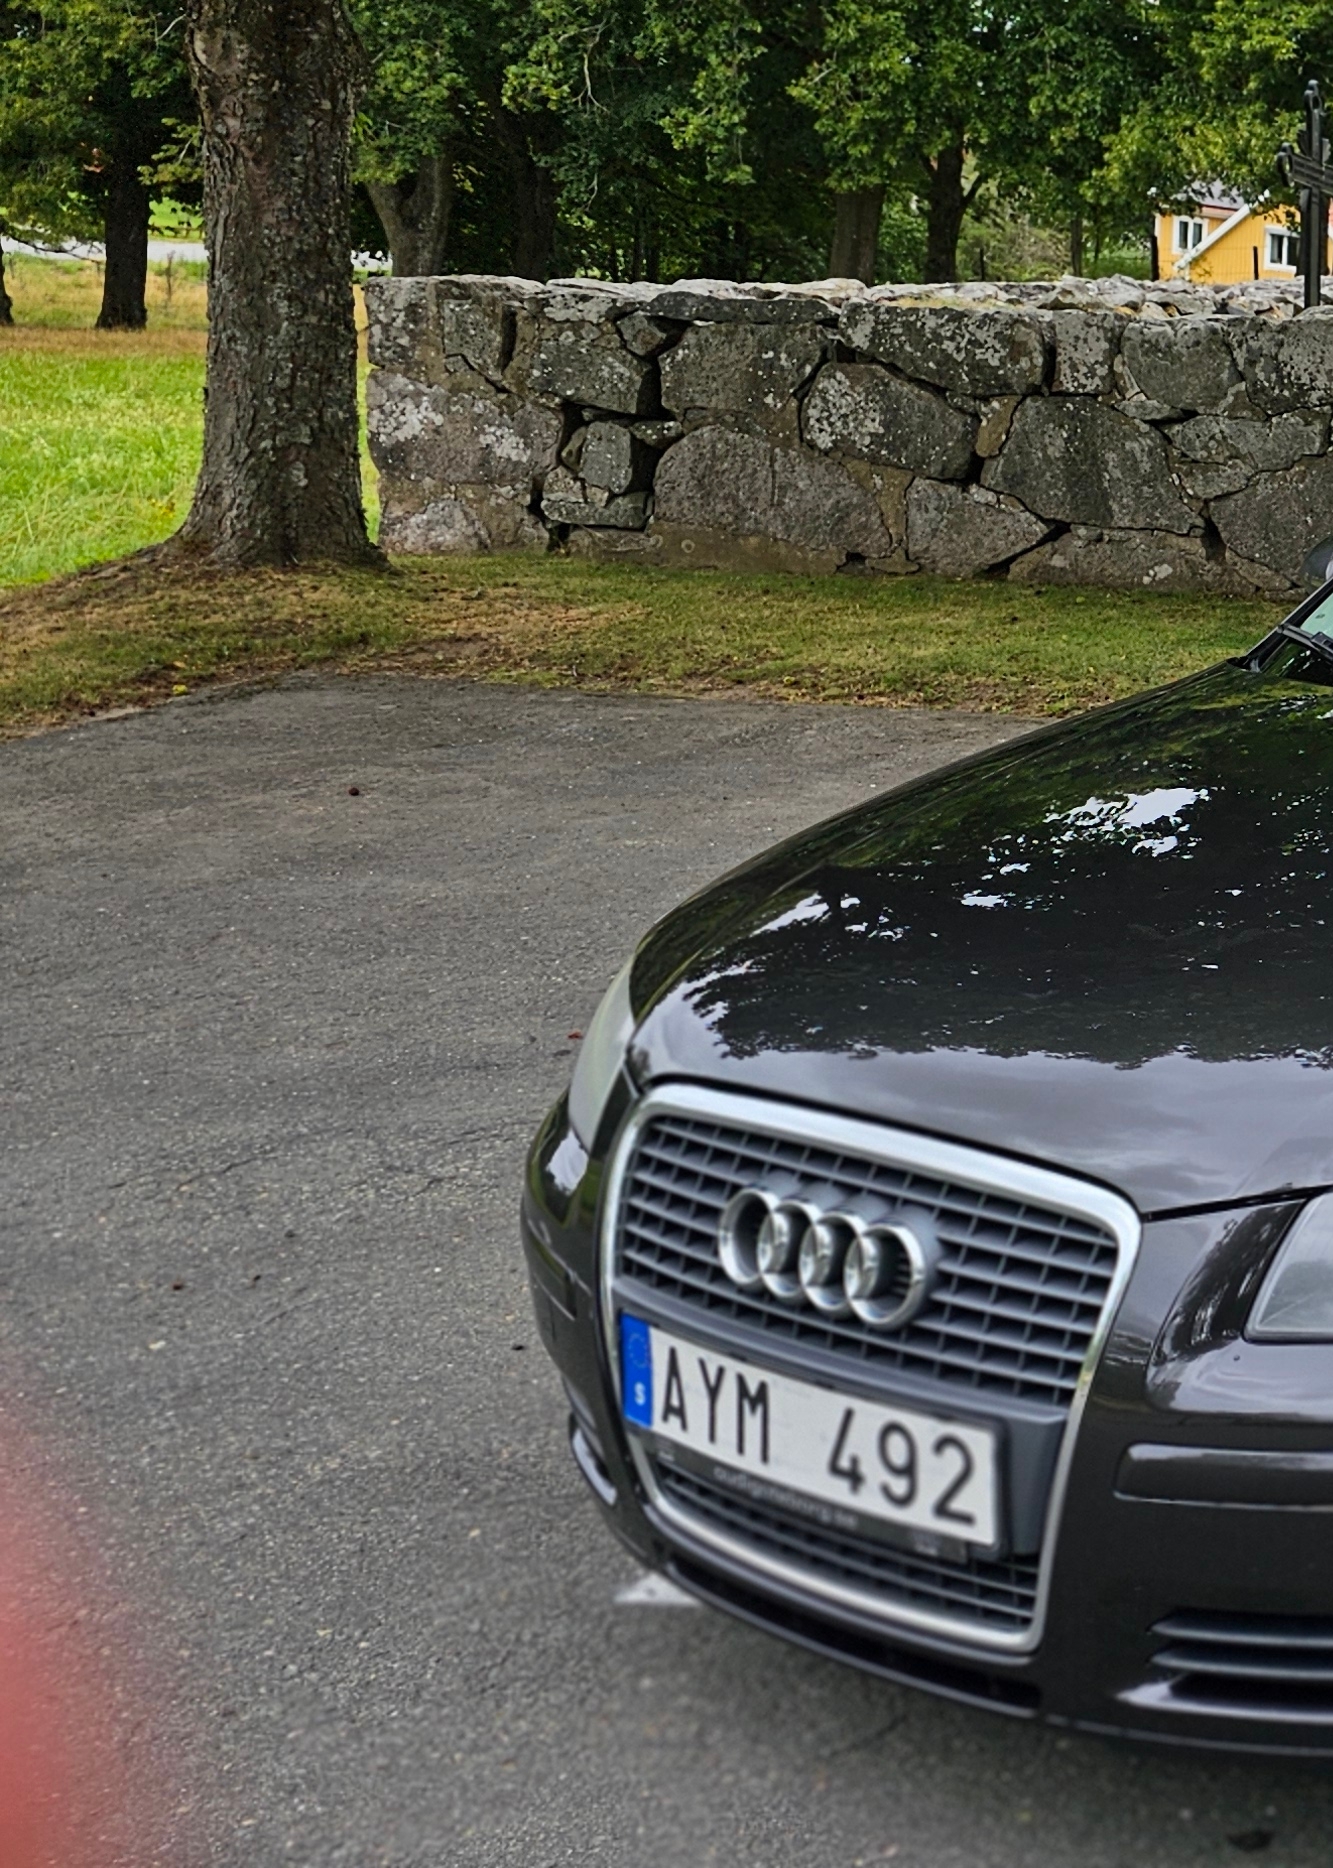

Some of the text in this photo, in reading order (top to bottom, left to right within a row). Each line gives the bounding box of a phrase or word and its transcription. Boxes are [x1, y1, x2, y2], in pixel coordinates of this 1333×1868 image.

[634, 1381, 646, 1406] S
[661, 1345, 976, 1527] AYM 492
